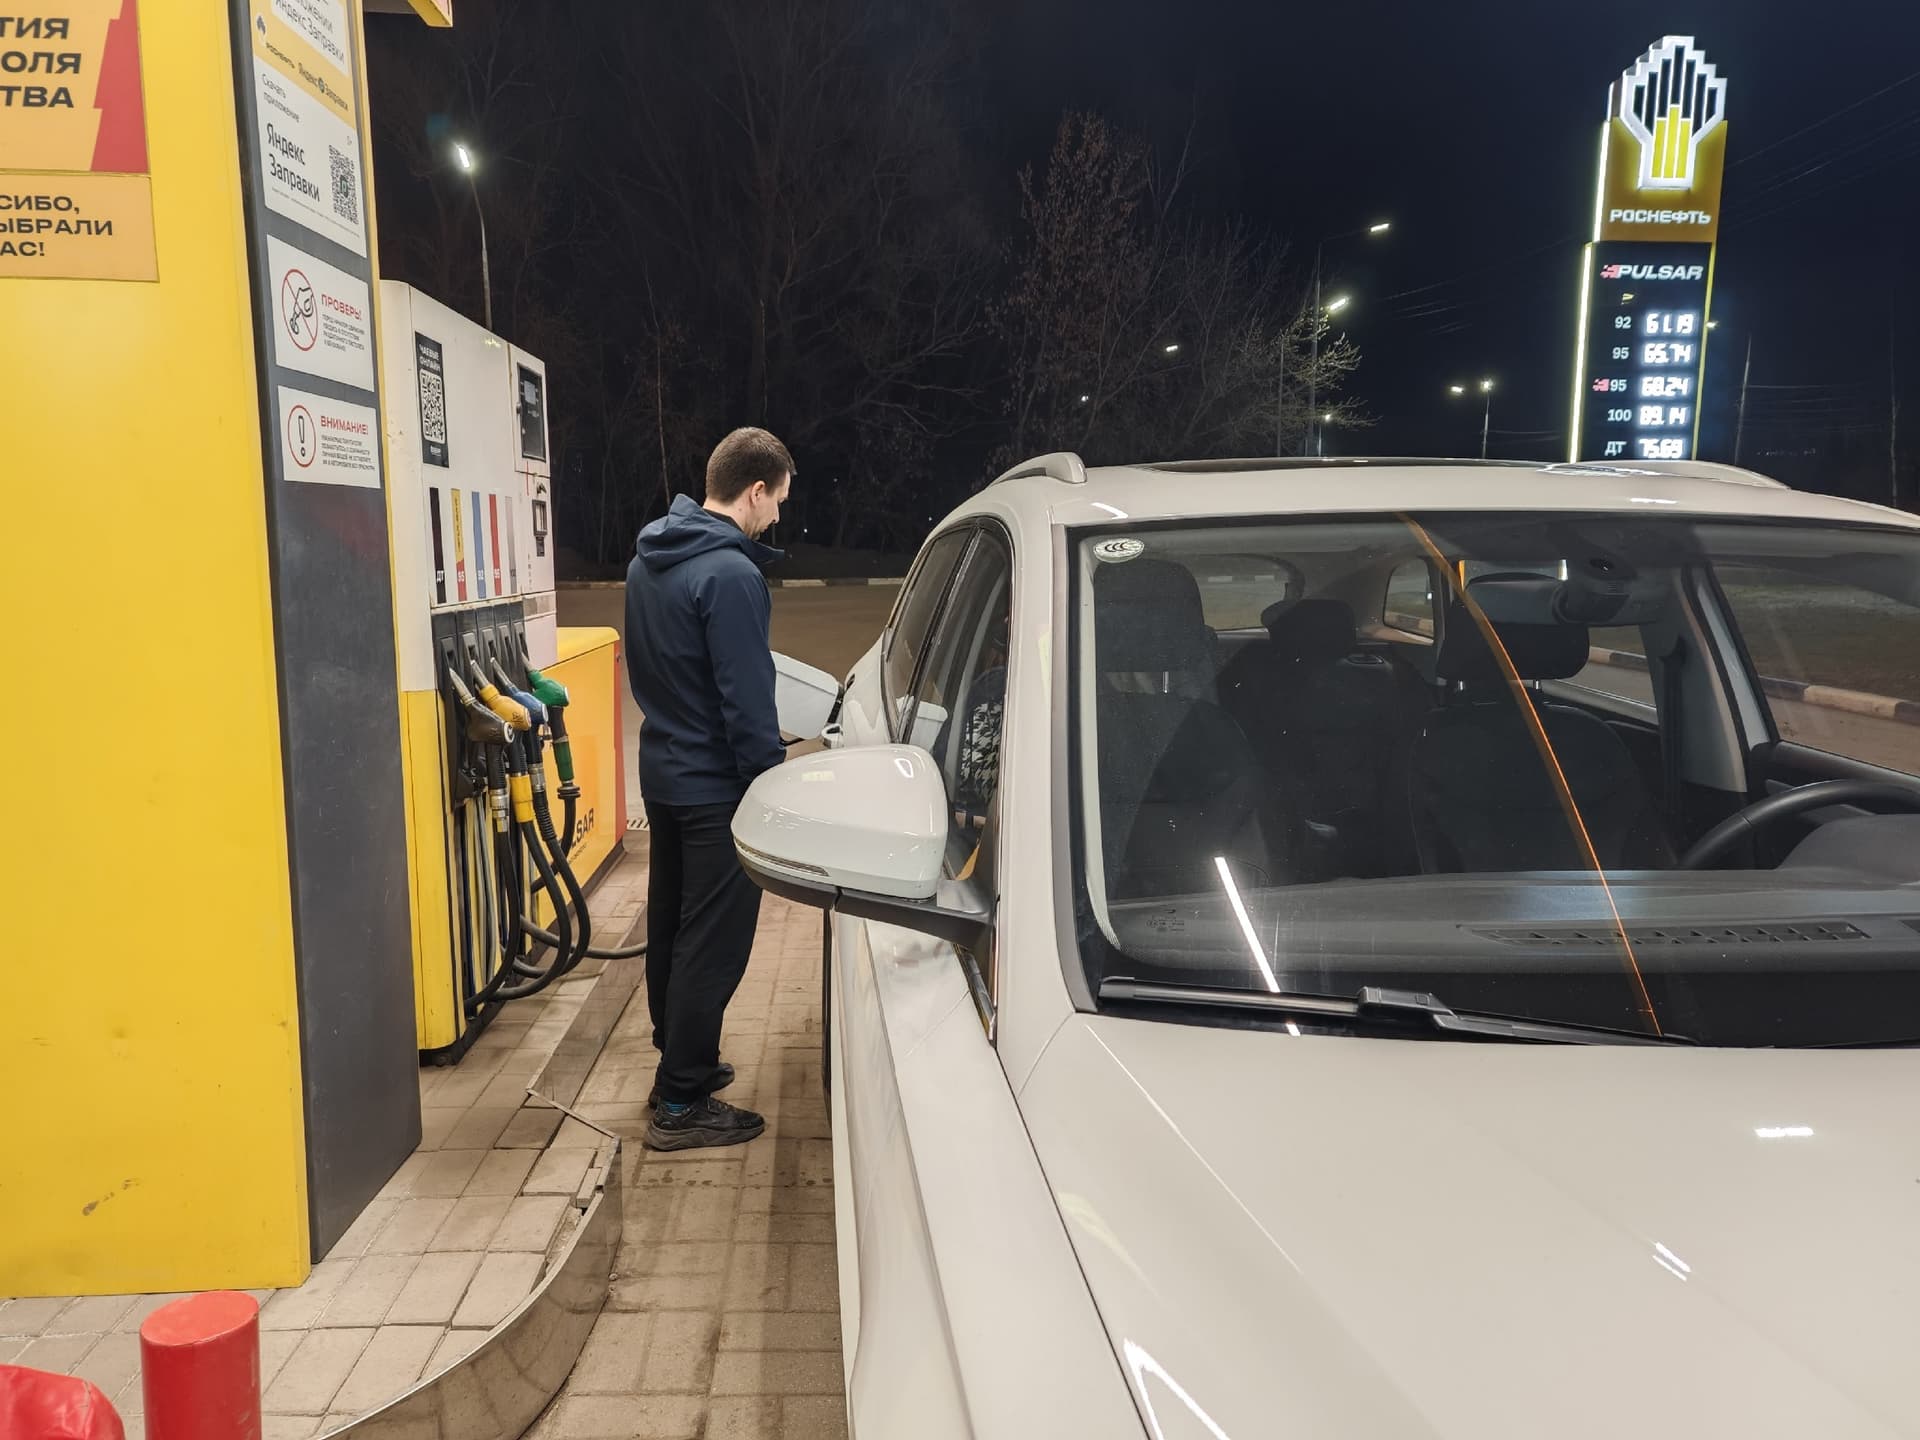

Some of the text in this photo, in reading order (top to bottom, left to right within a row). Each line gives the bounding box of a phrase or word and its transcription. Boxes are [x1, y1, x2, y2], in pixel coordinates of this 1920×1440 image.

[1, 51, 82, 74] ОЛЯ
[0, 85, 75, 108] ТВА
[266, 123, 306, 165] Яндекс
[269, 153, 321, 202] Заправки
[1609, 209, 1711, 225] РОСНЕФТЬ
[0, 241, 45, 257] АС!
[1616, 264, 1703, 280] PULSAR
[1615, 316, 1632, 329] 92
[1612, 347, 1629, 359] 95
[1610, 379, 1627, 391] 95
[1607, 409, 1632, 421] 100
[320, 415, 369, 436] ВНИМАНИЕ!
[1605, 441, 1626, 456] ДТ
